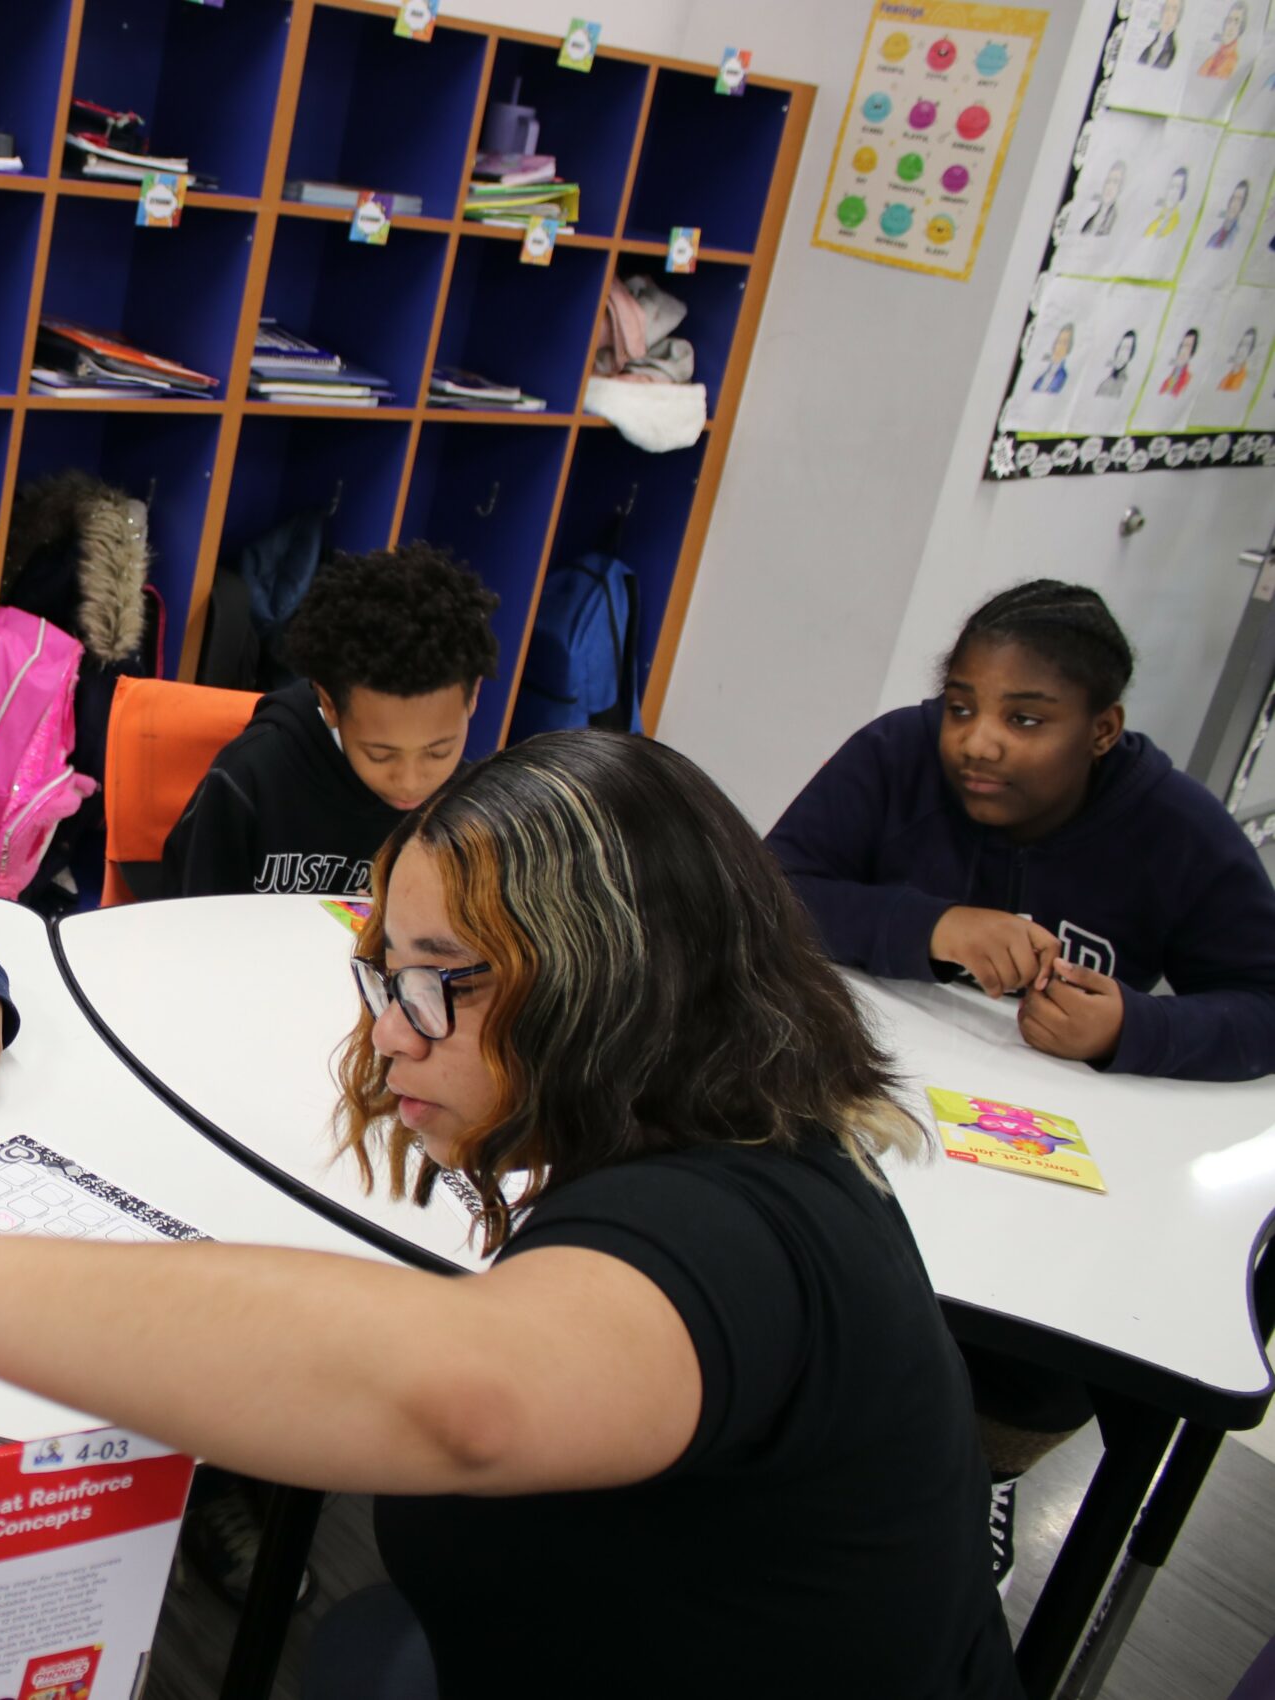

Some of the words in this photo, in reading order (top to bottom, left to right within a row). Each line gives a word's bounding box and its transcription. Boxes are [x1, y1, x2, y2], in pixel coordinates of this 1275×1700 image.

[254, 853, 347, 894] JUST
[76, 1439, 129, 1462] 4-03
[29, 1474, 134, 1509] Reinforce
[36, 1666, 87, 1682] PHONICS
